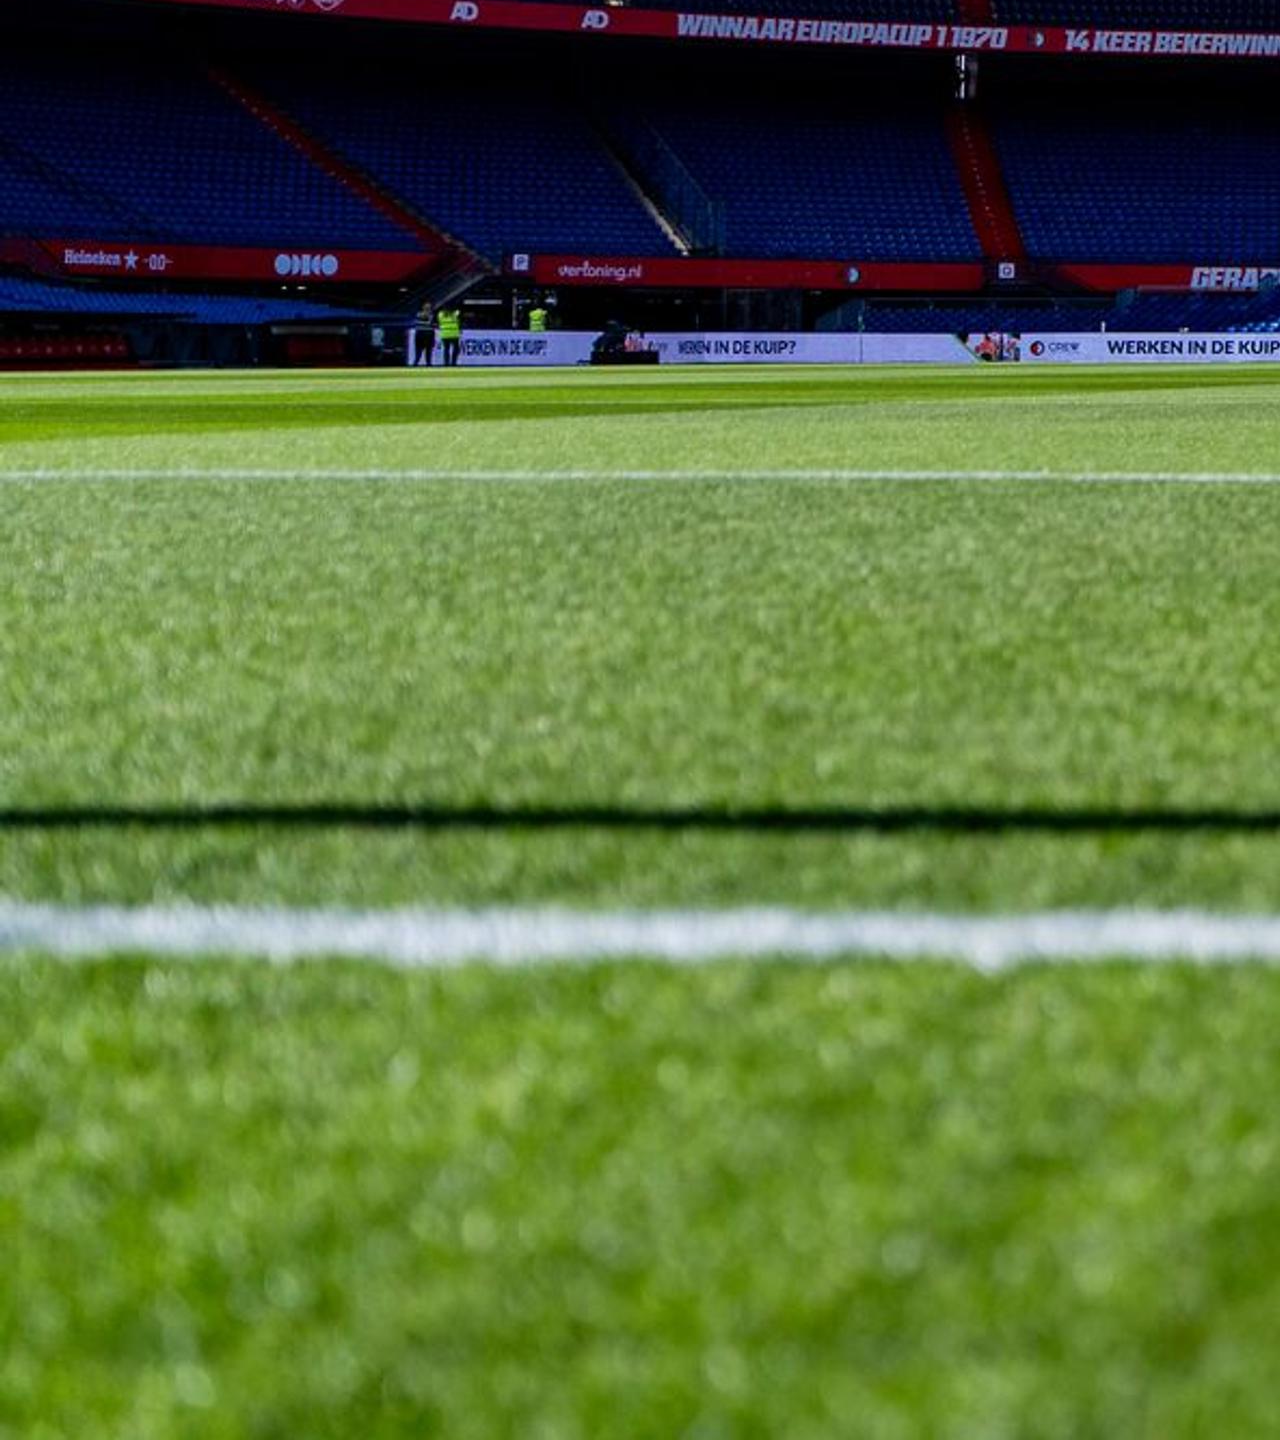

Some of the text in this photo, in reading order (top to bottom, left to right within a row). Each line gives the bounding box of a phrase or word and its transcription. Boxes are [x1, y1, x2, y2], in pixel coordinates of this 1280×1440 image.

[450, 1, 478, 21] AD
[580, 10, 609, 29] AD
[677, 14, 794, 41] WINNAAR
[950, 27, 1008, 49] 1970
[1064, 30, 1089, 50] 14
[1092, 30, 1152, 53] KEER
[64, 249, 122, 266] Heineken
[714, 340, 728, 355] IN
[731, 340, 751, 355] DE
[753, 340, 797, 356] KUIP?
[1107, 341, 1183, 355] WERKEN
[1188, 341, 1208, 355] IN
[1211, 341, 1234, 355] DE
